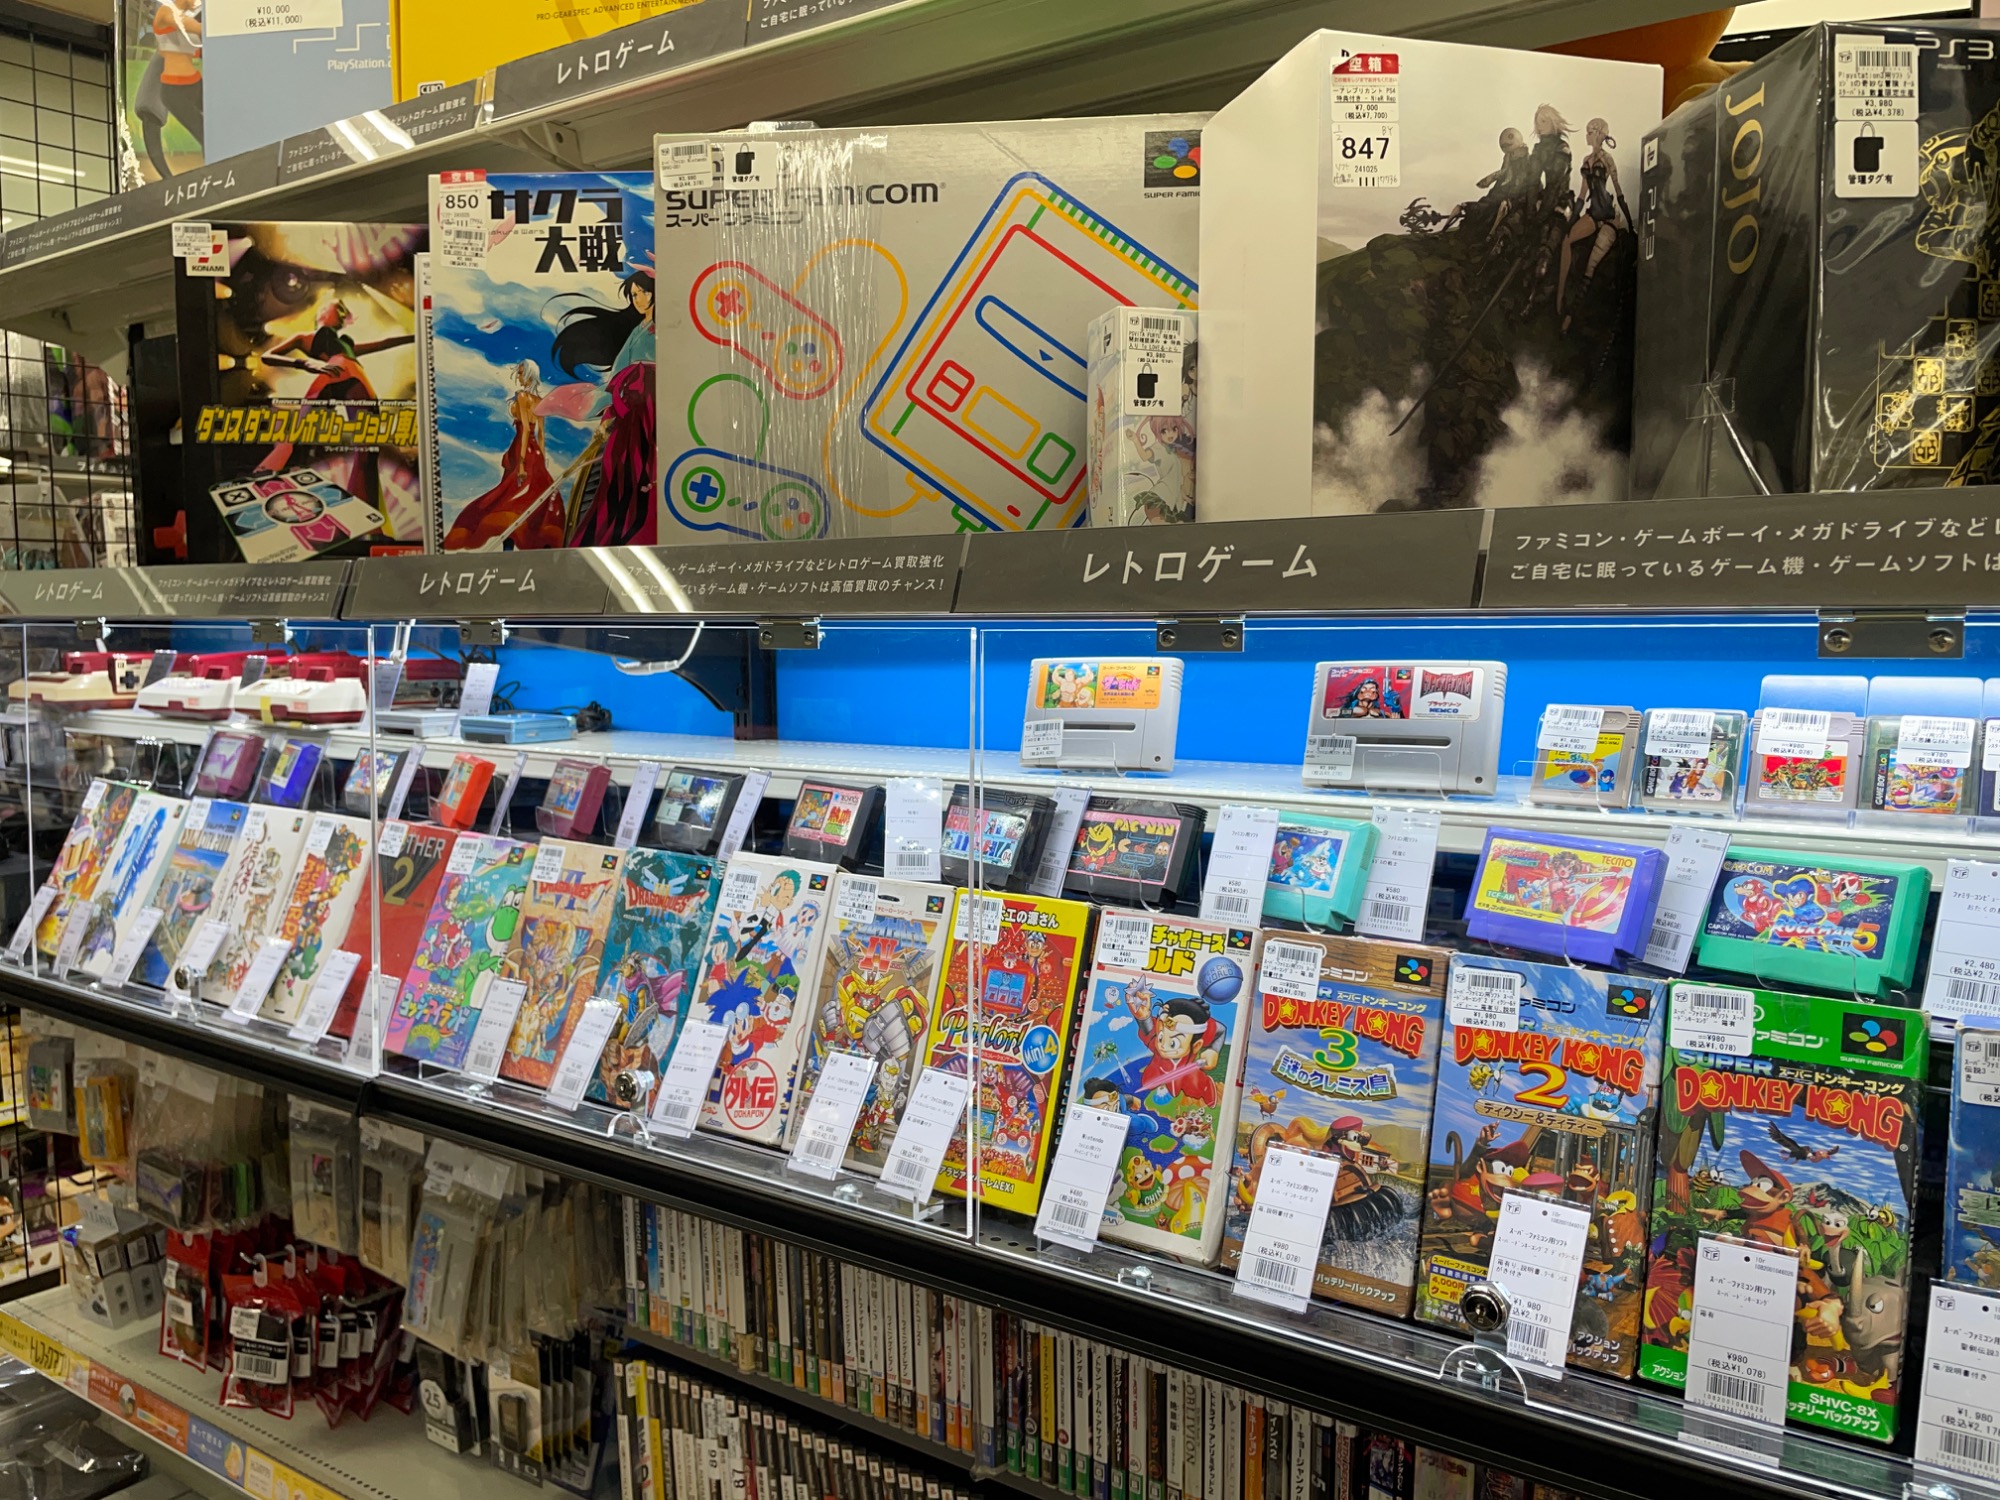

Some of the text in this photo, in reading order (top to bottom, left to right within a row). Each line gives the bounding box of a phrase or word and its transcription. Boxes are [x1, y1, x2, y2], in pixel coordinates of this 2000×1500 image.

[256, 5, 291, 16] ¥10,000
[593, 3, 635, 15] ADVANCED
[245, 15, 303, 28] (税込¥11,000)
[1915, 36, 1996, 61] PS3
[328, 58, 385, 72] PlayStation
[556, 31, 676, 86] レトロゲーム
[1348, 56, 1382, 72] 空箱
[1869, 89, 1915, 98] 数量限定生産
[1851, 108, 1905, 118] (税込¥4,378)
[1864, 99, 1894, 108] ¥3,980
[1341, 137, 1390, 159] 847
[1354, 165, 1378, 173] 241025
[1722, 81, 1766, 275] JOJO
[164, 169, 236, 208] レトロゲーム
[1848, 174, 1894, 185] 管理タグ有
[445, 194, 479, 209] 850
[487, 188, 623, 225] サクラ
[665, 187, 773, 211] SUPER
[534, 225, 624, 274] 大戦
[271, 398, 377, 407] Dance Dance Revolution
[1133, 399, 1165, 408] 管理タグ有
[1082, 543, 1321, 585] レトロゲーム
[419, 565, 537, 596] レトロゲーム
[34, 581, 104, 602] レトロゲーム
[1427, 700, 1463, 708] ブラックソーン
[1646, 780, 1656, 794] GAME
[1874, 753, 1889, 806] GAME BOY COLOR
[1114, 818, 1177, 837] PAC-MAN
[403, 832, 447, 860] THER
[1601, 854, 1634, 868] TECMO
[1722, 861, 1774, 876] CAPCOM
[383, 855, 416, 907] 2
[1219, 885, 1249, 895] (税込¥638)
[1385, 886, 1401, 894] ¥580
[625, 876, 669, 910] DRAGON
[1374, 893, 1409, 903] (税込¥638)
[1486, 890, 1515, 902] TCF-AH
[1663, 912, 1677, 920] ¥580
[1150, 923, 1228, 955] チャイニーズ
[1771, 918, 1881, 952] ROCKMAN 5
[1964, 958, 1996, 971] ¥2,480
[1205, 967, 1234, 986] WORLD
[1269, 985, 1308, 998] (税込¥1,078)
[1336, 991, 1428, 1014] スーパードンキーコング
[395, 991, 473, 1037] ヨッシーアイランド
[1462, 1018, 1507, 1029] (税込¥2,178)
[1473, 1012, 1497, 1020] ¥1,980
[933, 1009, 1035, 1055] Parlor!
[1262, 993, 1426, 1060] DONKEY KONG
[1540, 1021, 1646, 1049] スーパードンキーコング
[1685, 1039, 1737, 1053] (税込¥1,078)
[1707, 1034, 1726, 1044] ¥980
[1024, 1034, 1059, 1065] Mini 4
[1312, 1027, 1360, 1072] 3
[1454, 1025, 1646, 1097] DONKEY KONG
[1677, 1048, 1774, 1077] SUPER
[1840, 1055, 1865, 1065] SUPER
[1276, 1053, 1392, 1097] 謎のクレミス島
[1778, 1066, 1905, 1095] スーパードンキーコング
[727, 1075, 776, 1110] 外伝
[1513, 1061, 1571, 1110] 2
[733, 1109, 765, 1118] DOKAPON
[1482, 1103, 1599, 1133] ディクシー&ディディー
[1675, 1066, 1906, 1151] DONKEY KONG
[1069, 1188, 1083, 1197] ¥480
[1144, 1185, 1164, 1206] CHIN
[1273, 1239, 1290, 1251] ¥980
[1508, 1227, 1569, 1248] スーパーファミコン用ソフト
[1257, 1245, 1302, 1264] (税込¥1,078)
[776, 1248, 785, 1288] OROCHI
[1496, 1265, 1522, 1279] がき付き
[1315, 1272, 1397, 1303] バッテリーバックアップ
[1432, 1276, 1466, 1292] 4,000円
[1709, 1274, 1777, 1297] スーパーファミコン用ソフト
[1513, 1296, 1542, 1312] ¥1,980
[1512, 1306, 1552, 1325] 込¥2,178)
[1576, 1331, 1621, 1351] アクション
[1726, 1350, 1749, 1365] ¥980
[1651, 1363, 1687, 1382] アクション
[1707, 1357, 1767, 1380] (税込¥1,078)
[1809, 1392, 1878, 1419] SHVC-8X
[1957, 1406, 1994, 1424] ¥1,980
[1185, 1384, 1197, 1466] OBLIVION
[731, 1468, 746, 1490] 87
